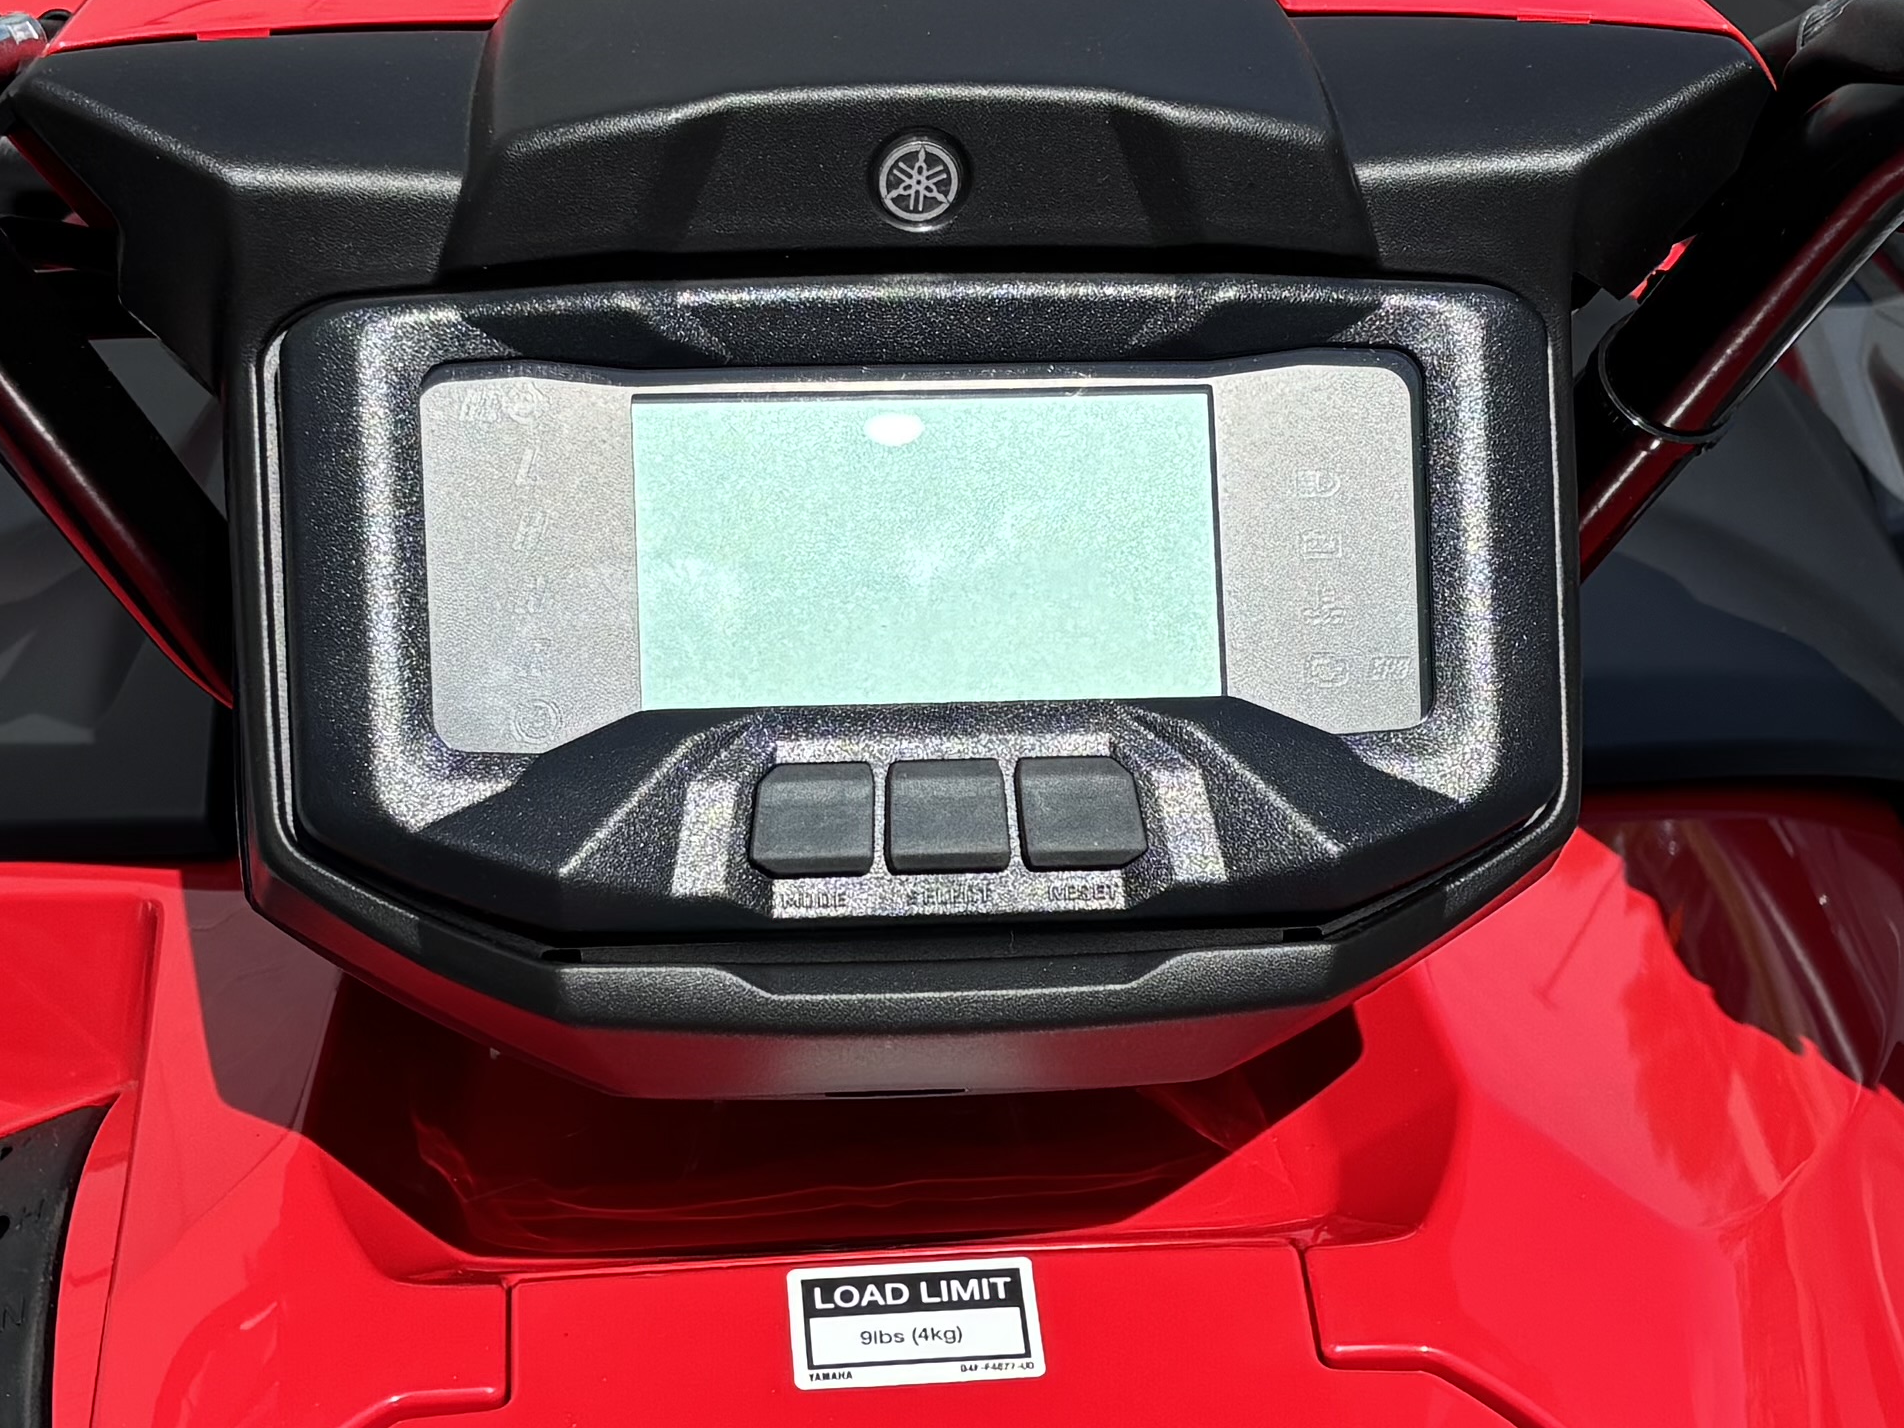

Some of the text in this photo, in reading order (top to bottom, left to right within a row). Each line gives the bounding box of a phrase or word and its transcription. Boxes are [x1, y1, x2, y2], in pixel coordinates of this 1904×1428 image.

[813, 1277, 1011, 1309] LOAD LIMIT
[0, 1293, 27, 1333] N
[860, 1326, 963, 1346] 9lbs (4kg)
[809, 1371, 853, 1382] YAMAHA
